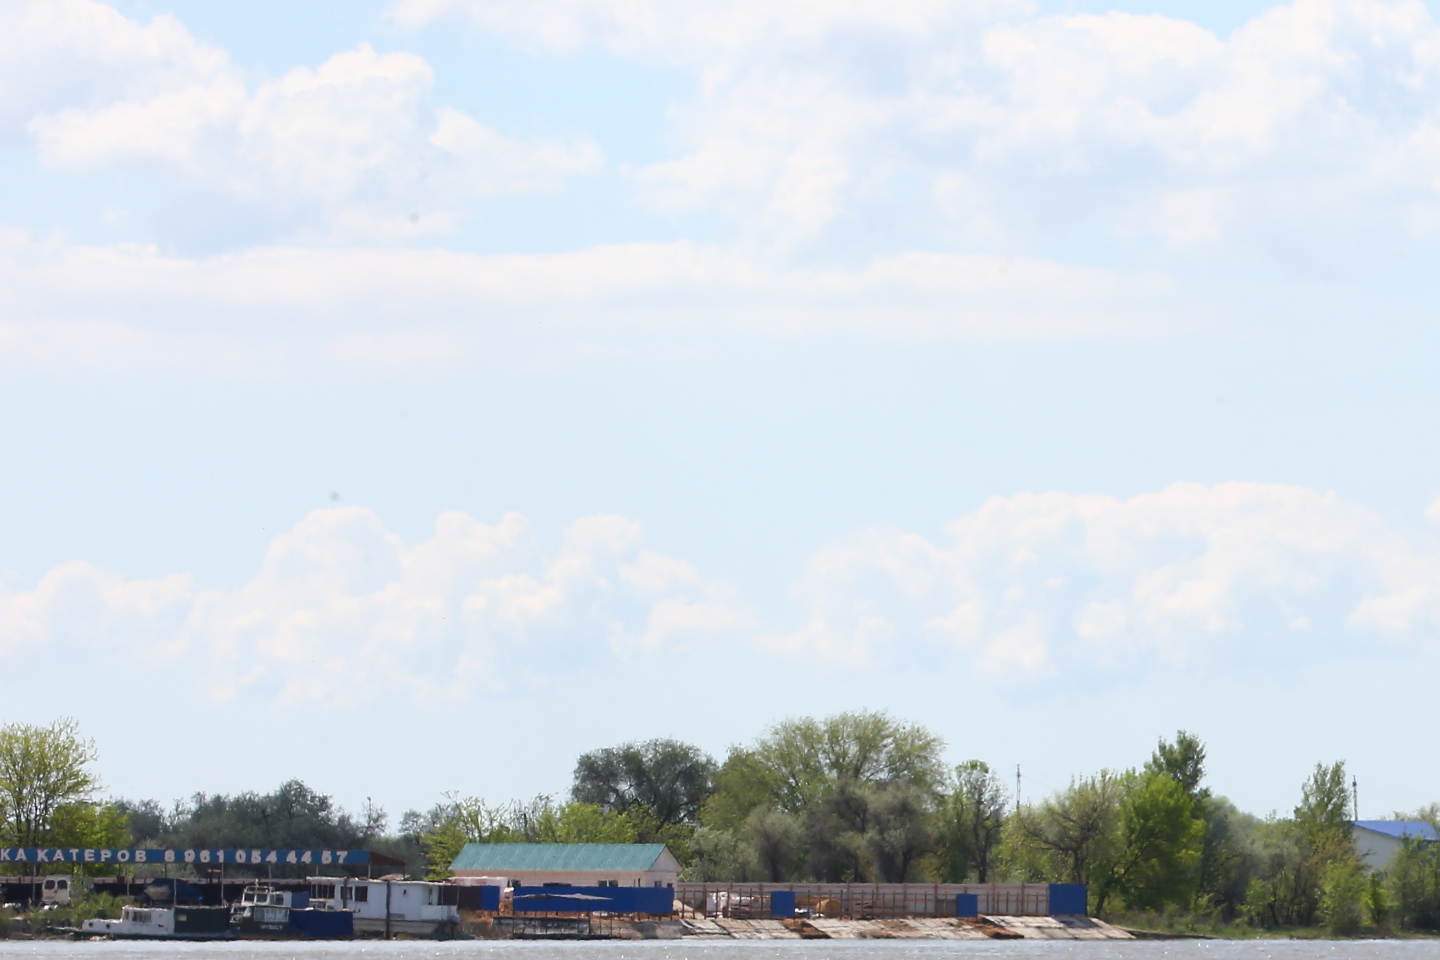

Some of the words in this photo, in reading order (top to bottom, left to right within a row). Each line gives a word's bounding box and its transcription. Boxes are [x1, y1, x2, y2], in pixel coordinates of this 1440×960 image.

[37, 848, 147, 862] КАТЕРОВ
[164, 849, 175, 862] 8
[184, 849, 224, 863] 961
[235, 849, 277, 864] 054
[286, 850, 312, 864] 44
